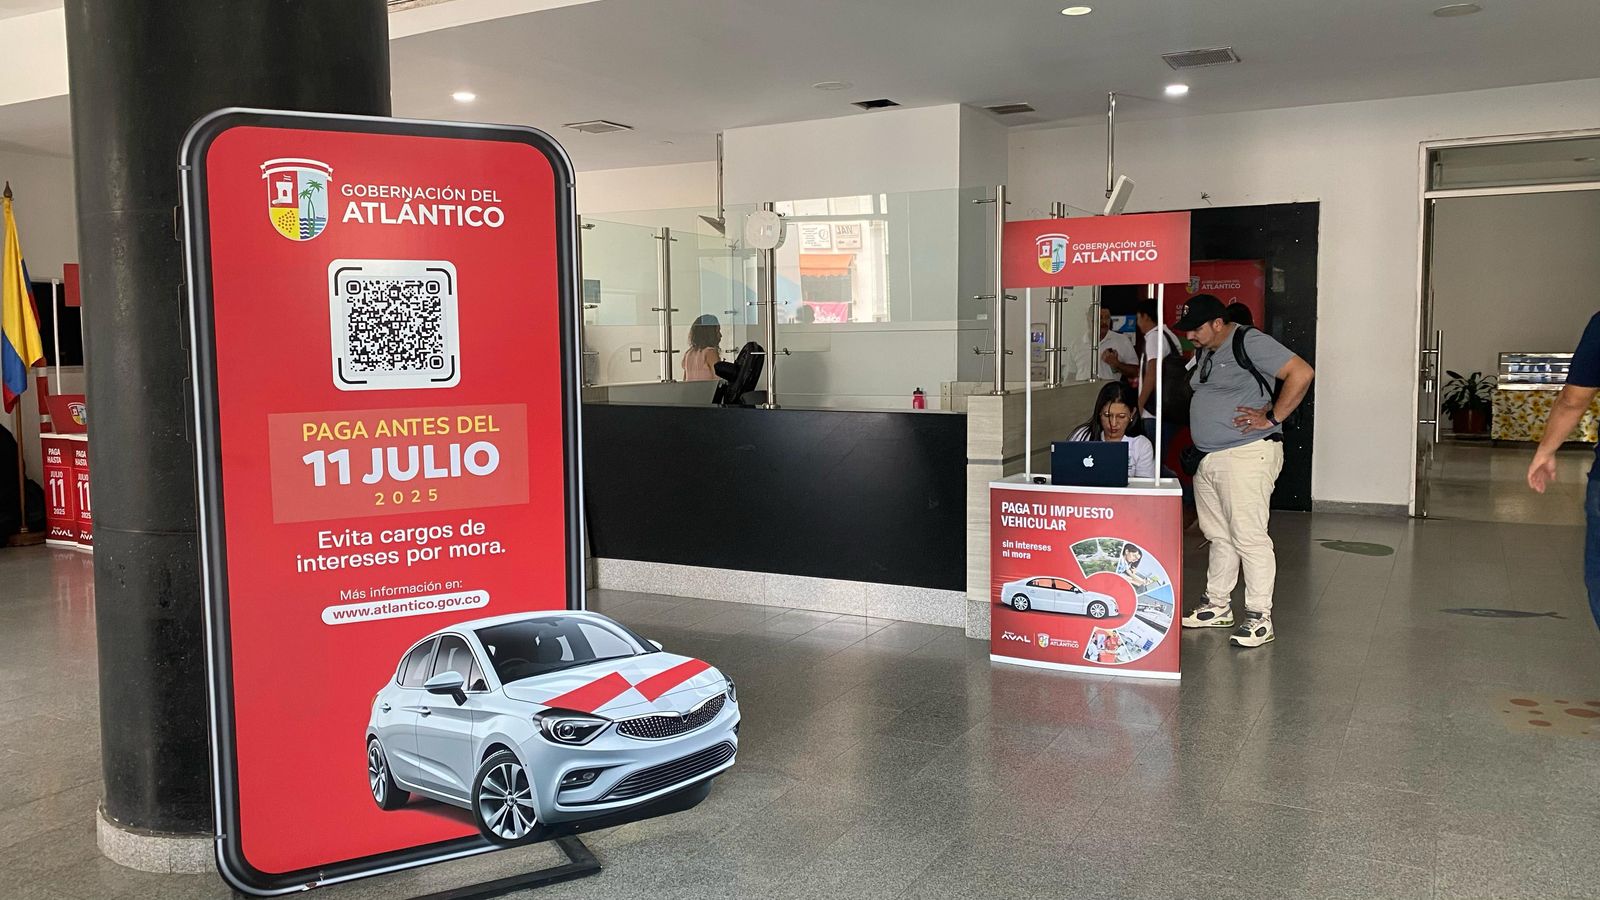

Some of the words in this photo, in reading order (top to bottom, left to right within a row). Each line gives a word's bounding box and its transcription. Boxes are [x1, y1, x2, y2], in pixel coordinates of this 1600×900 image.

[341, 184, 466, 201] GOBERNACIÓN
[471, 188, 502, 203] DEL
[342, 198, 505, 228] ATLÁNTICO
[1072, 240, 1137, 251] GOBERNACIÓN
[1139, 240, 1157, 248] DEL
[1072, 248, 1158, 264] ATLÁNTICO
[1202, 282, 1240, 290] ATLÁNTICO
[302, 421, 368, 442] PAGA
[375, 417, 450, 438] ANTES
[457, 415, 500, 434] DEL
[302, 448, 350, 487] 11
[361, 441, 500, 485] JULIO
[50, 478, 65, 507] 11
[77, 481, 91, 511] 11
[375, 488, 438, 506] 2025
[1001, 501, 1030, 515] PAGA
[1032, 503, 1047, 516] TU
[1050, 505, 1114, 520] IMPUESTO
[1001, 515, 1066, 531] VEHICULAR
[318, 529, 373, 550] Evita
[380, 524, 453, 547] cargos
[459, 519, 486, 536] de
[1002, 540, 1014, 549] sin
[1015, 541, 1052, 552] intereses
[1002, 550, 1011, 558] ni
[1011, 551, 1032, 560] mora
[296, 547, 400, 573] intereses
[406, 546, 442, 567] por
[449, 540, 506, 559] mora.
[340, 587, 366, 601] Más
[369, 581, 442, 598] información
[445, 579, 463, 590] en:
[333, 595, 481, 620] www.atlantico.gov.co
[1002, 633, 1031, 642] AVAL
